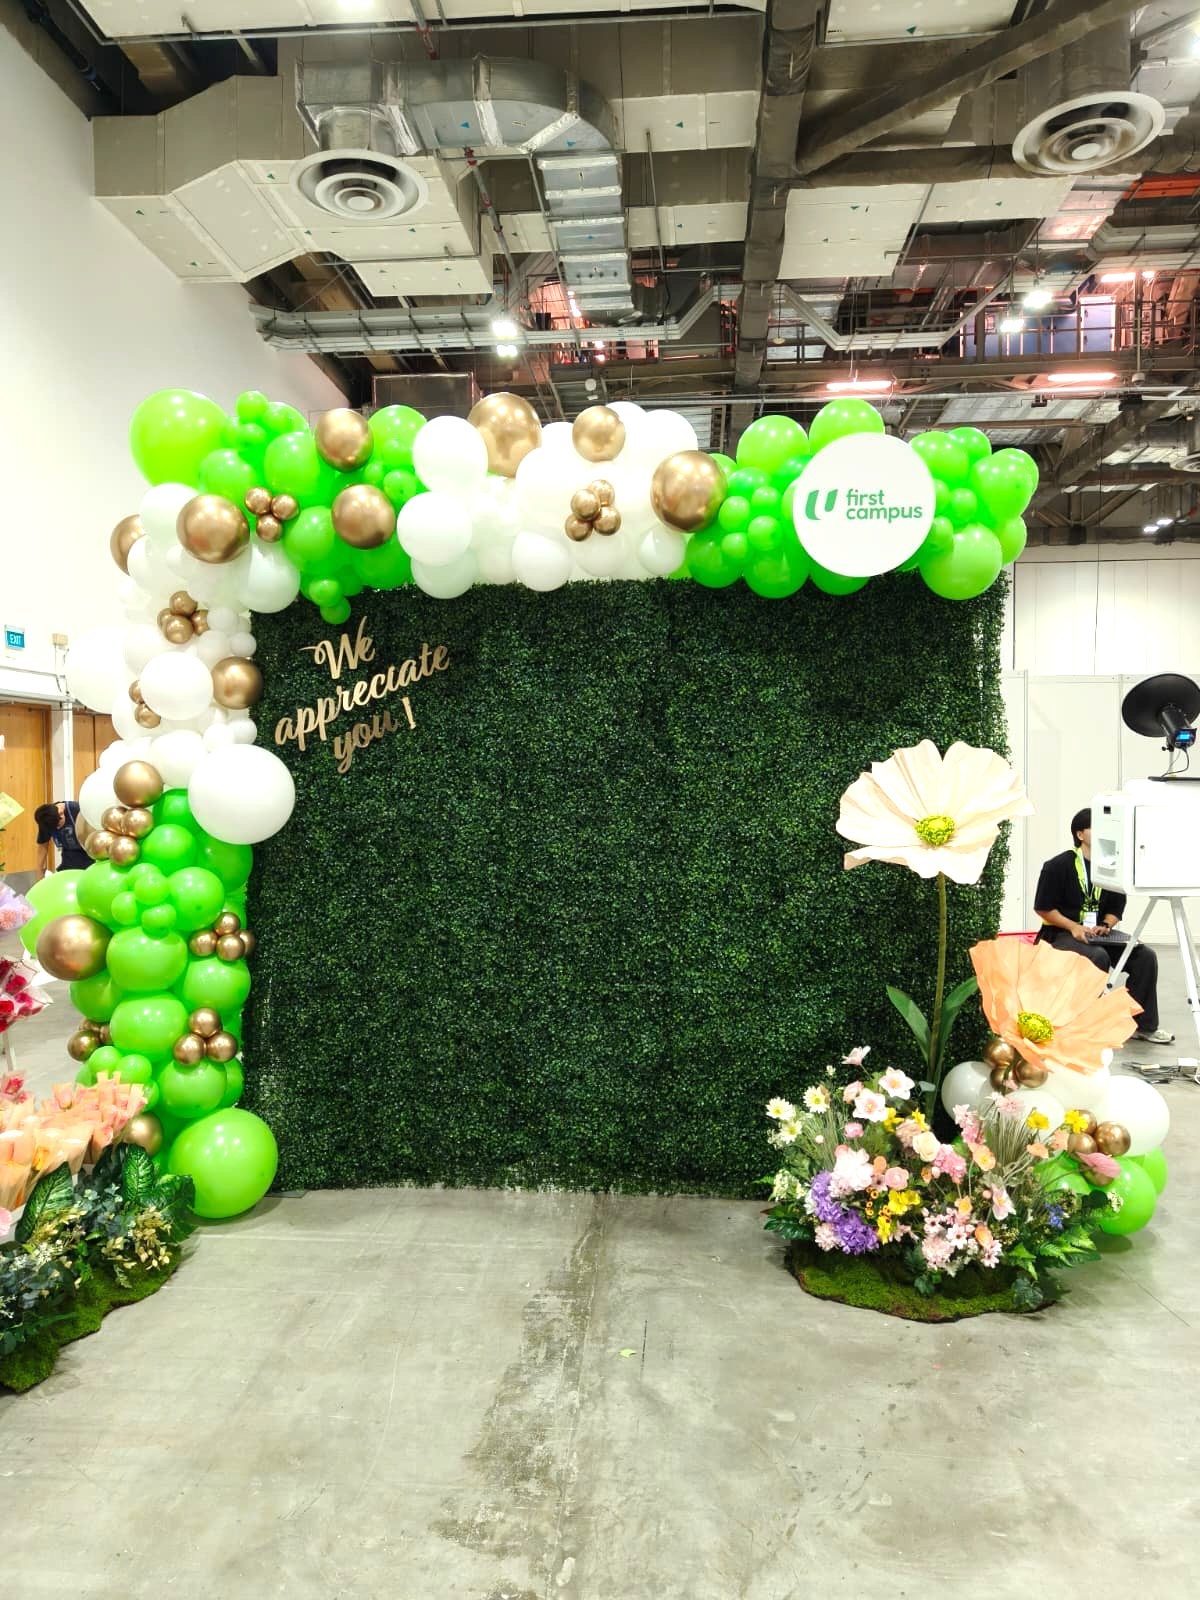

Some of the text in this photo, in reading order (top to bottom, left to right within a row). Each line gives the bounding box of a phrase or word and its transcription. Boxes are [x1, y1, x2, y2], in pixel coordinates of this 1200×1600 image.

[846, 488, 885, 506] first
[846, 505, 923, 523] campus
[10, 633, 22, 645] EXIT
[299, 616, 375, 679] We
[275, 643, 449, 751] appreciate
